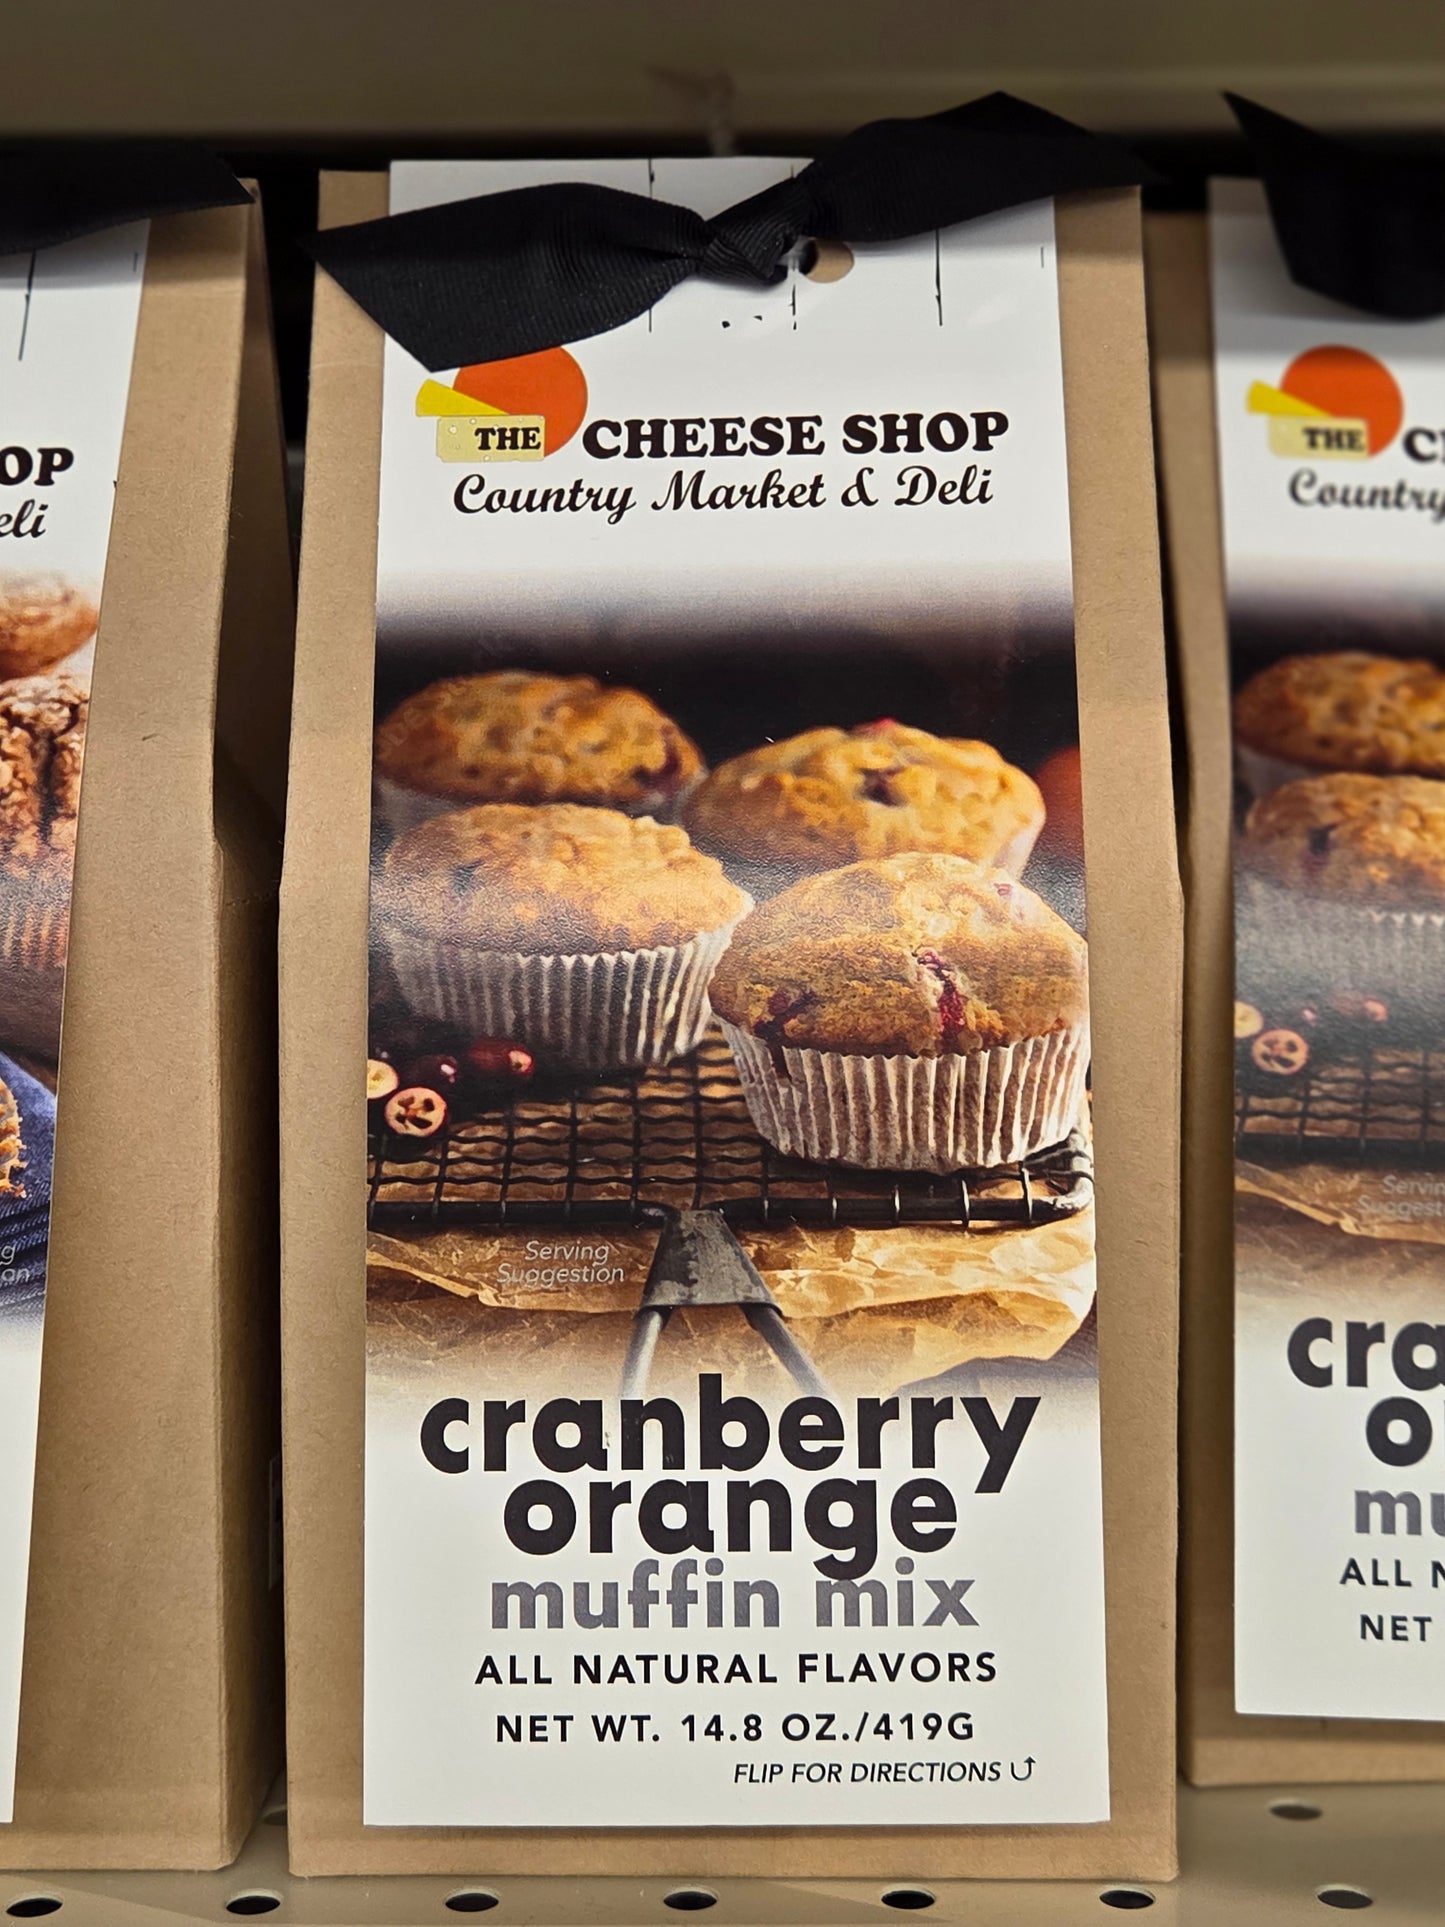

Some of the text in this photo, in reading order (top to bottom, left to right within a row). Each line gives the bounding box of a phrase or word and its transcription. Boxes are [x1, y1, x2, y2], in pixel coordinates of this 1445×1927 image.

[474, 411, 1009, 459] THE CHEESE SHOP
[1302, 427, 1365, 451] THE
[453, 464, 994, 525] Country Market & Deli
[524, 1239, 609, 1267] Serving
[496, 1262, 625, 1288] Suggestion
[420, 1372, 1041, 1494] cranberry
[503, 1477, 957, 1580] orange
[1339, 1557, 1412, 1588] ALL
[491, 1556, 979, 1630] muffin mix
[1360, 1614, 1432, 1642] NET
[474, 1651, 996, 1685] ALL NATURAL FLAVORS
[496, 1711, 974, 1743] NET WT. 14.8 OZ./419G
[733, 1761, 1002, 1784] FLIP FOR DIRECTIONS
